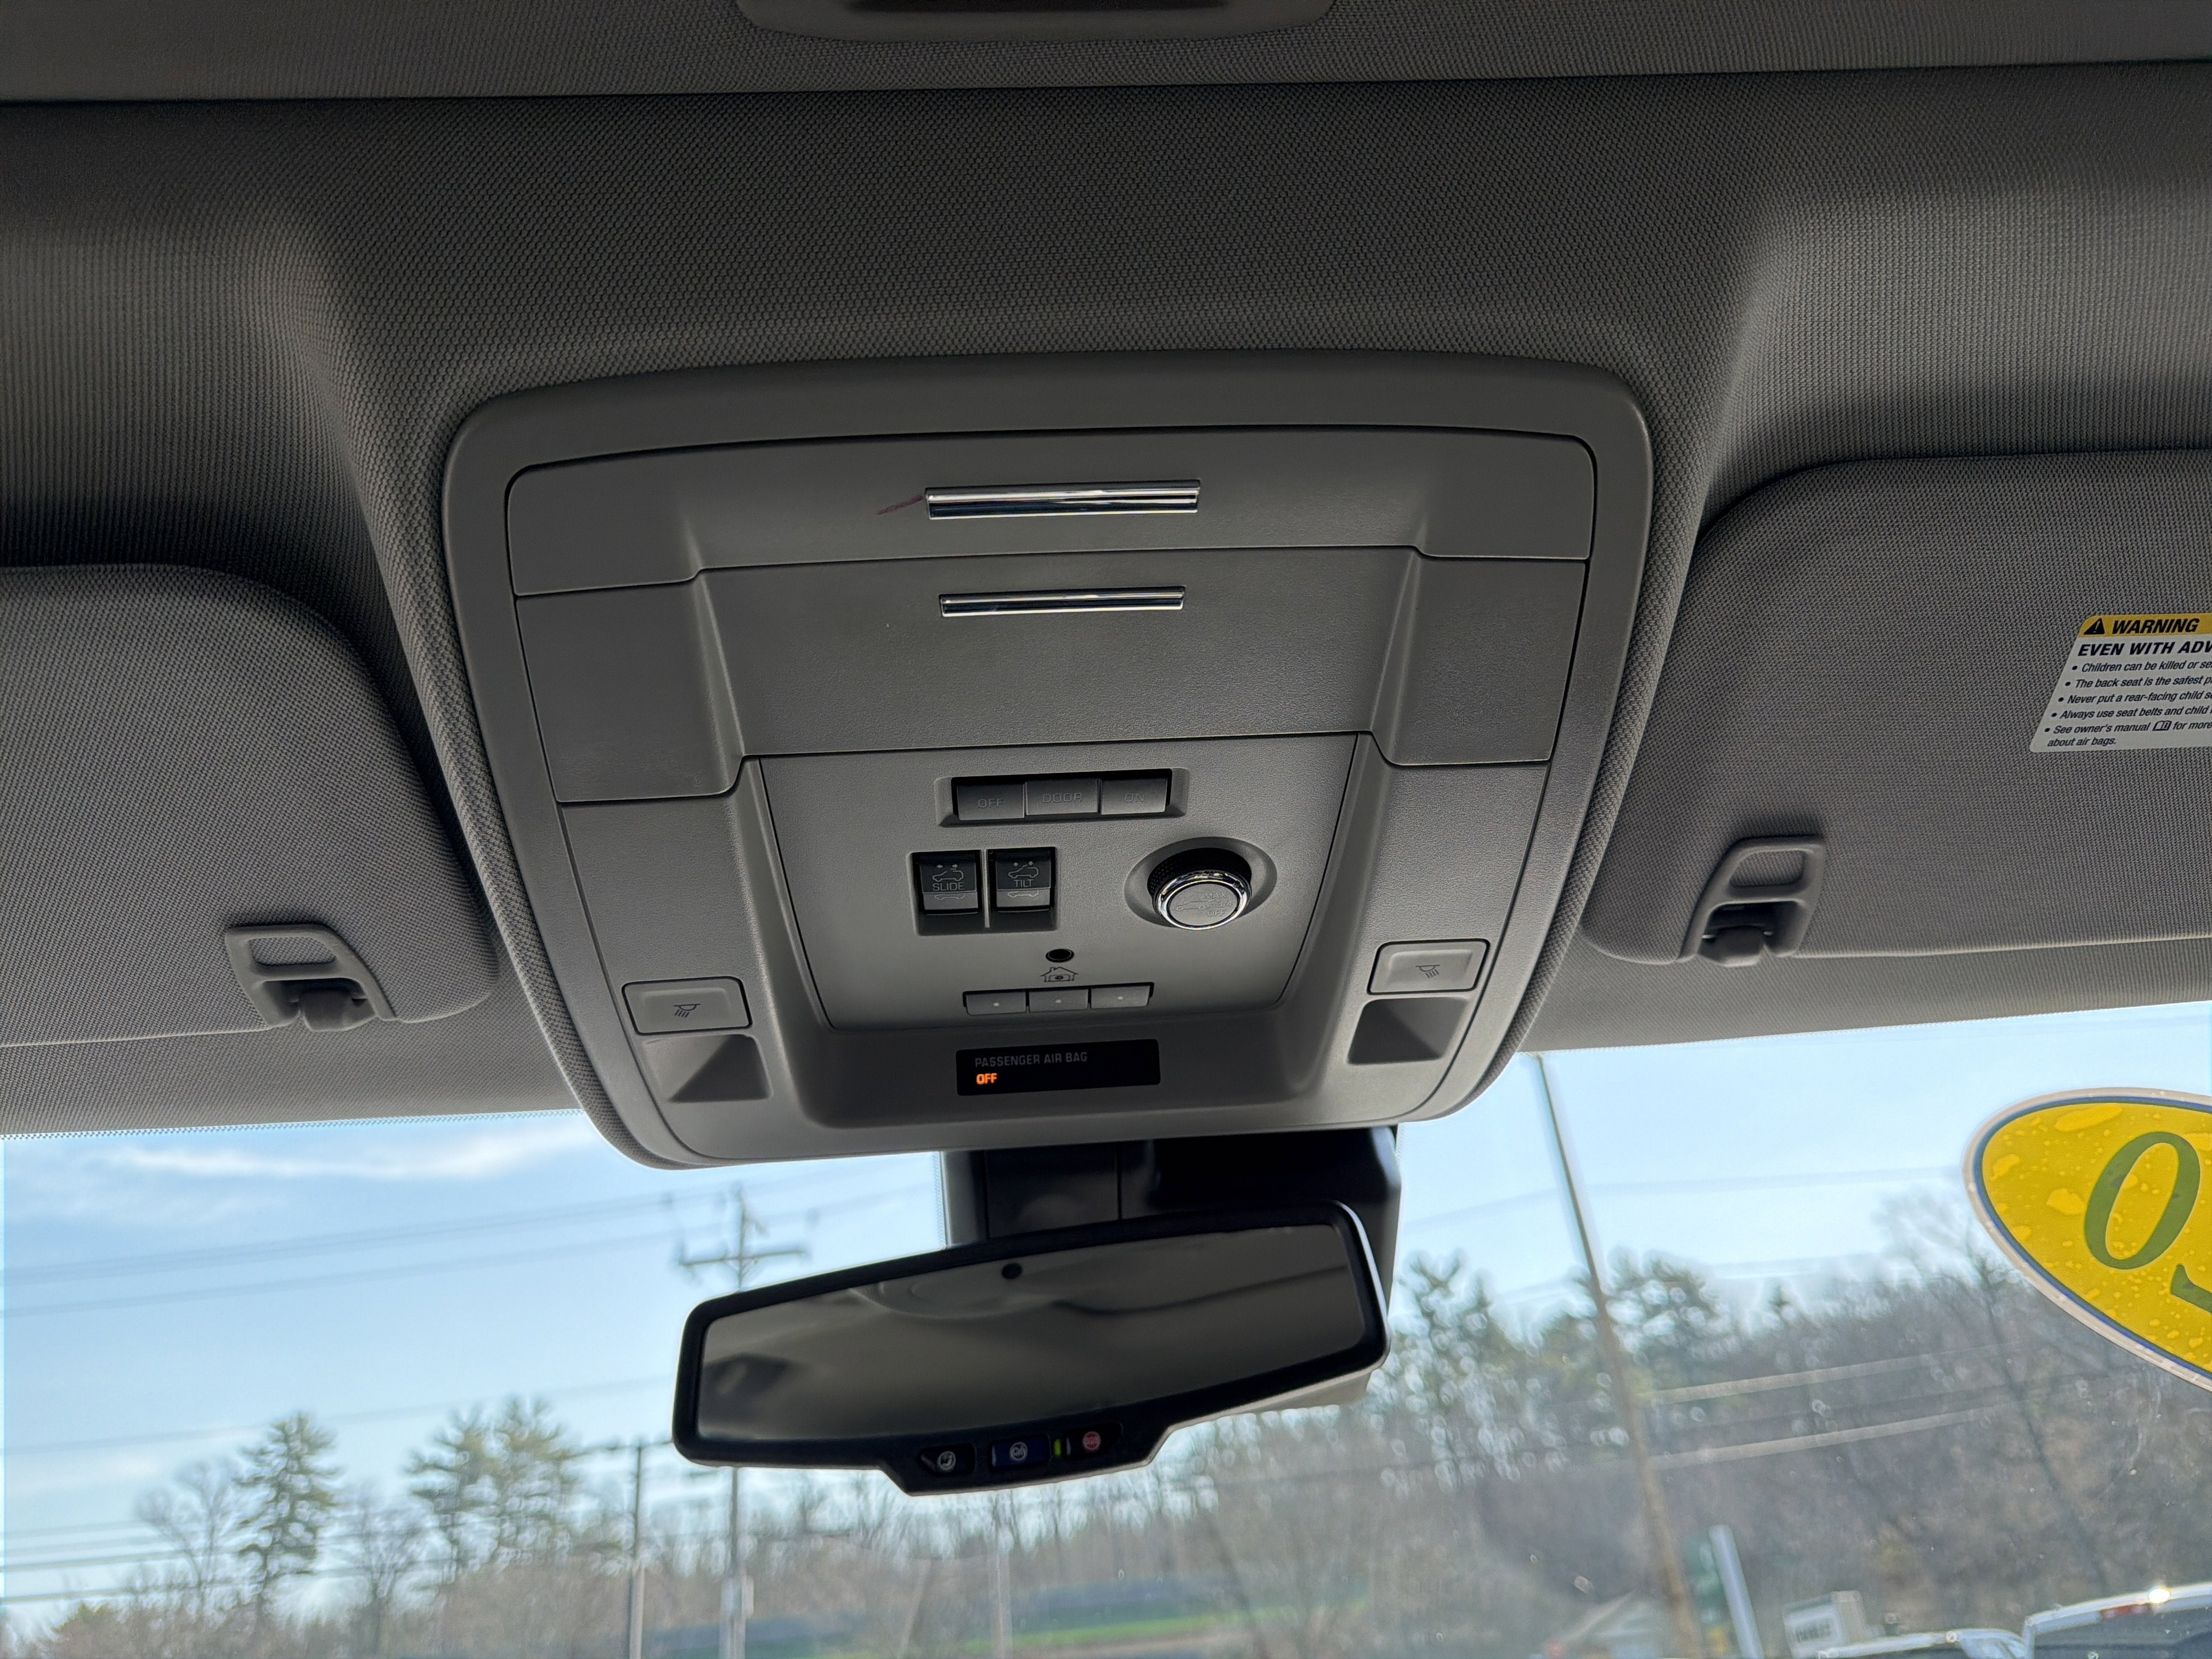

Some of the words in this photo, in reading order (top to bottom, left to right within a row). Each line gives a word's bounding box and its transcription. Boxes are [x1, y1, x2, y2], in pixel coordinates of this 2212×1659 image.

[2112, 618, 2200, 634] WARNING
[2078, 643, 2124, 657] EVEN
[2129, 641, 2175, 656] WITH
[2082, 662, 2122, 673] Children
[2144, 661, 2157, 670] be
[2159, 661, 2187, 670] killed
[2075, 679, 2095, 689] The
[2096, 678, 2120, 687] back
[2120, 678, 2141, 687] seat
[2145, 678, 2153, 686] is
[2155, 676, 2171, 685] the
[2172, 675, 2204, 685] safest
[2067, 695, 2095, 704] Never
[2096, 695, 2115, 704] put
[2124, 691, 2177, 703] rear-facing
[2179, 690, 2204, 700] child
[2059, 710, 2095, 720] Always
[2096, 710, 2113, 719] use
[2115, 708, 2137, 718] seat
[2140, 707, 2163, 716] belts
[2164, 706, 2184, 715] and
[2185, 706, 2210, 714] child
[2053, 725, 2072, 734] See
[2074, 723, 2112, 733] owner's
[2113, 722, 2151, 732] manual
[2172, 721, 2187, 730] for
[2188, 721, 2212, 730] more
[2047, 737, 2075, 747] about
[2076, 737, 2090, 746] air
[2091, 736, 2116, 747] bags.
[978, 798, 1005, 808] OFF
[1042, 792, 1083, 803] DOOR
[1124, 793, 1145, 803] ON
[933, 882, 964, 891] SLIDE
[1013, 879, 1034, 888] TILT
[1204, 891, 1227, 900] MAX
[975, 1054, 1040, 1068] PASSENGER
[1043, 1053, 1062, 1064] AIR
[1065, 1051, 1088, 1063] BAG
[977, 1073, 997, 1085] OFF
